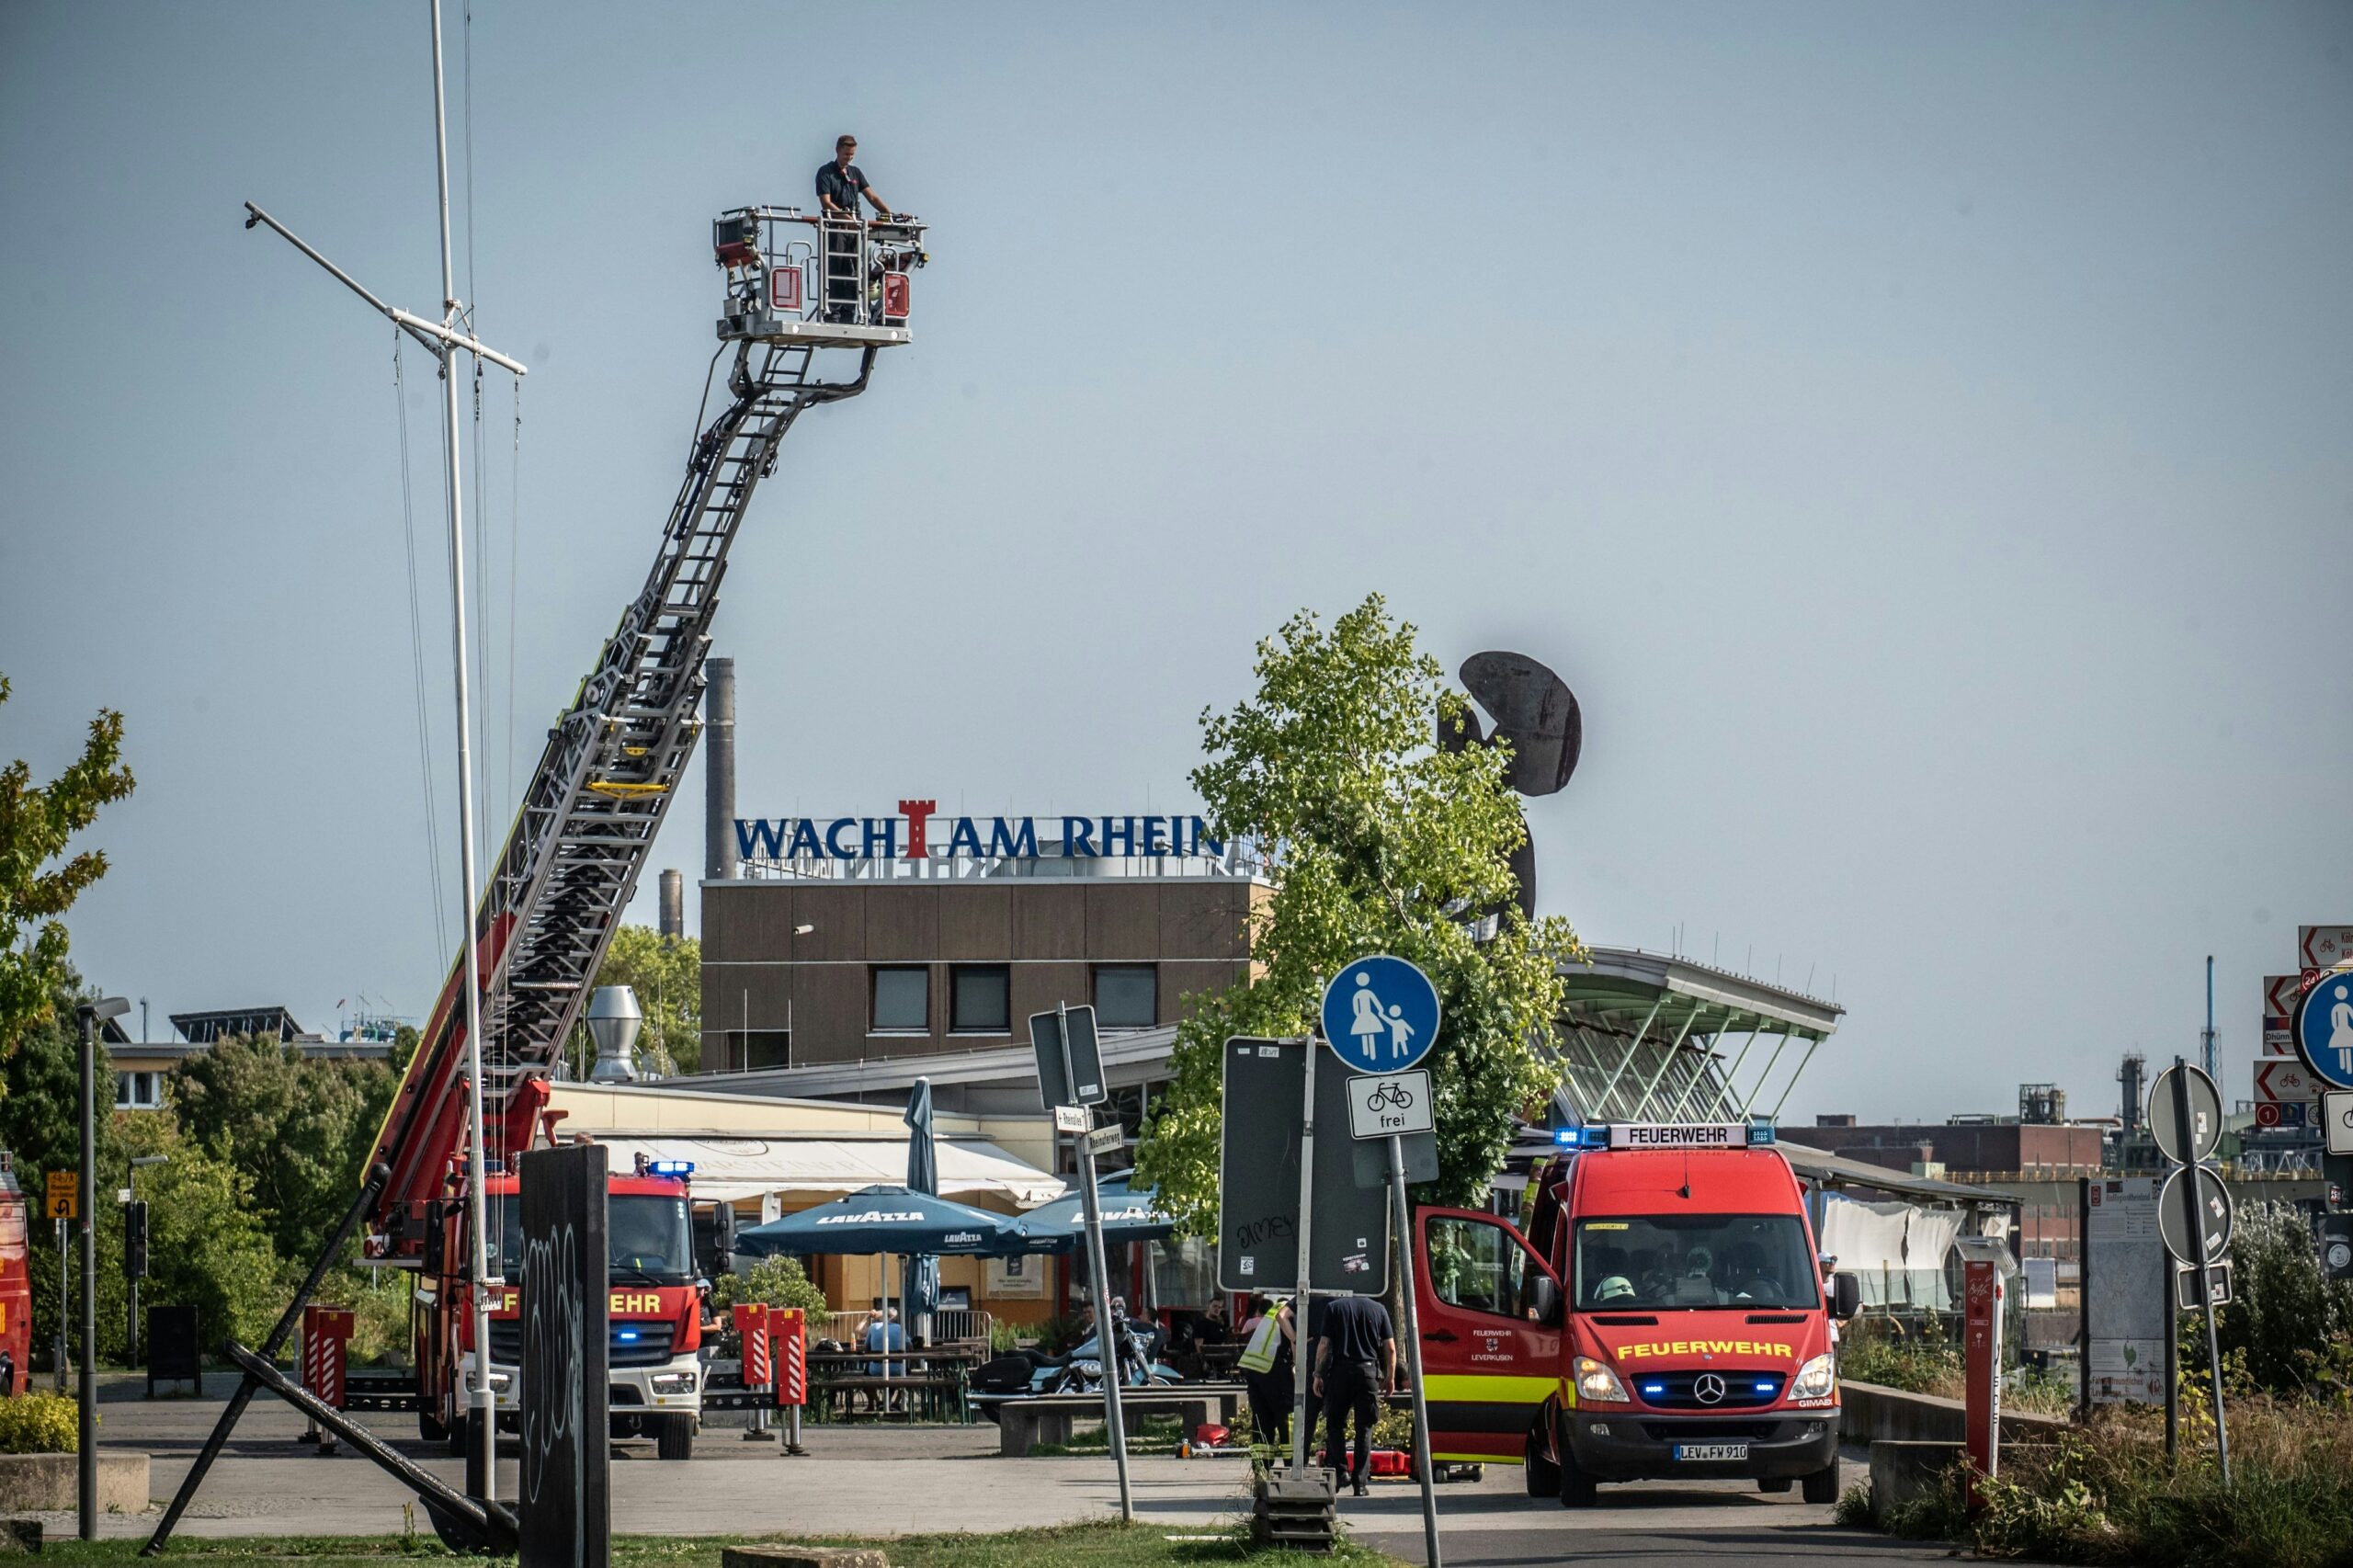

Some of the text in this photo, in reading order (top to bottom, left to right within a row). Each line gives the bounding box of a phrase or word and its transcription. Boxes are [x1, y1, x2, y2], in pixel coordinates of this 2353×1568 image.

[733, 801, 1224, 859] WACHT AM RHEIN
[2305, 977, 2314, 985] 24
[2266, 1032, 2290, 1040] Dhünn
[1381, 1113, 1404, 1128] frei
[1089, 1132, 1120, 1148] Rheinuferweg
[1630, 1128, 1727, 1143] FEUERWEHR
[816, 1211, 925, 1224] LAVAZZA
[944, 1232, 982, 1243] LAVAZZA
[1618, 1341, 1792, 1360] FEUERWEHR
[1799, 1398, 1833, 1408] GIMAEX
[1680, 1446, 1746, 1459] LEV FW 910
